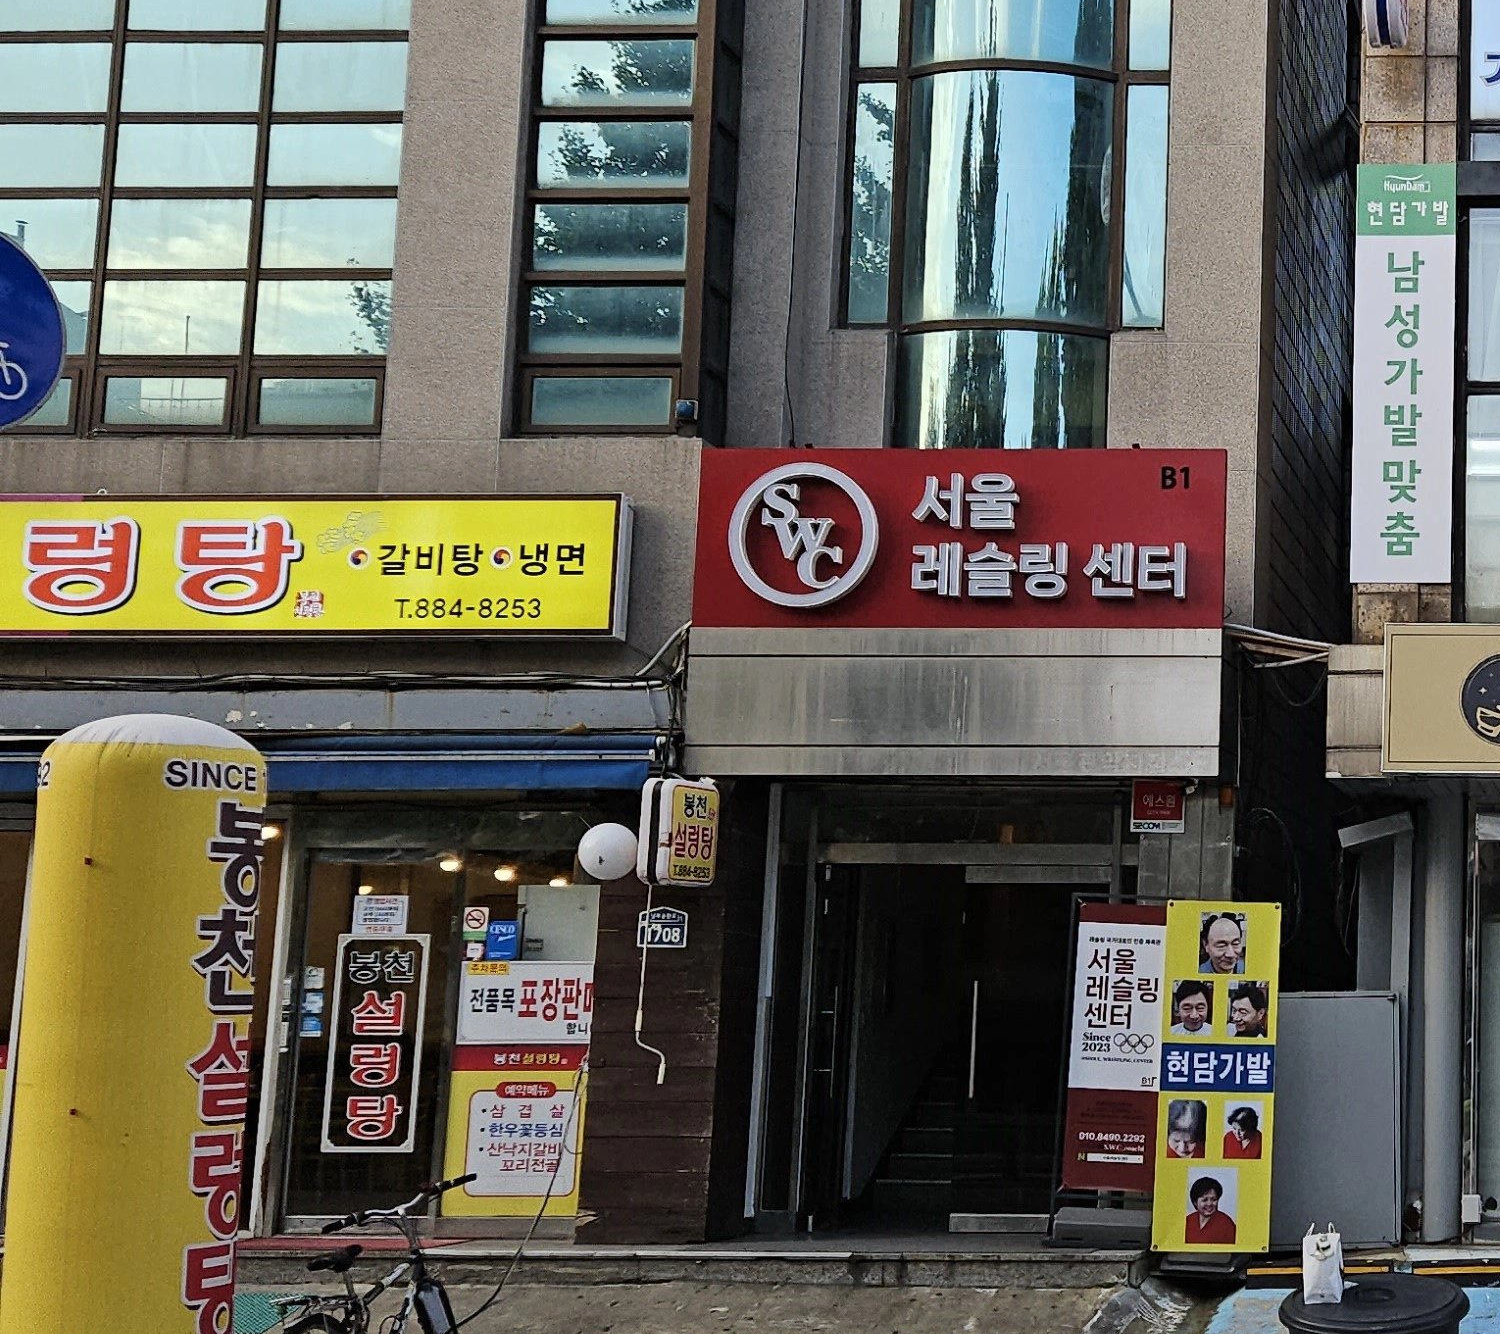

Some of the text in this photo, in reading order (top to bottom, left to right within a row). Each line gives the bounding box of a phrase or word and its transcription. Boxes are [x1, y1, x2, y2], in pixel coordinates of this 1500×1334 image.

[1383, 178, 1426, 194] HyunDam
[1366, 200, 1449, 227] 현담가발
[1160, 465, 1191, 490] B1
[911, 472, 1021, 530] 서울
[376, 542, 586, 577] 갈비탕 냉면
[911, 541, 1187, 599] 레슬링 센터
[394, 598, 542, 619] T.884-8253
[165, 759, 258, 792] SINCE
[683, 792, 708, 820] 봉천
[1142, 794, 1176, 808] 에스원
[646, 927, 682, 943] 1708
[349, 950, 415, 984] 봉천
[1087, 948, 1137, 975] 서울
[470, 987, 516, 1013] 전품목
[1085, 975, 1160, 1004] 레슬링
[1083, 1002, 1133, 1030] 센터
[565, 1023, 592, 1036] 합니
[1081, 1031, 1111, 1043] Since
[1081, 1042, 1111, 1053] 2023
[1166, 1050, 1272, 1085] 현담가발
[504, 1084, 550, 1097] 예약메뉴
[489, 1104, 566, 1119] 삼겹살
[488, 1122, 563, 1138] 한우꽃등심
[486, 1142, 562, 1157] 산낙지갈비
